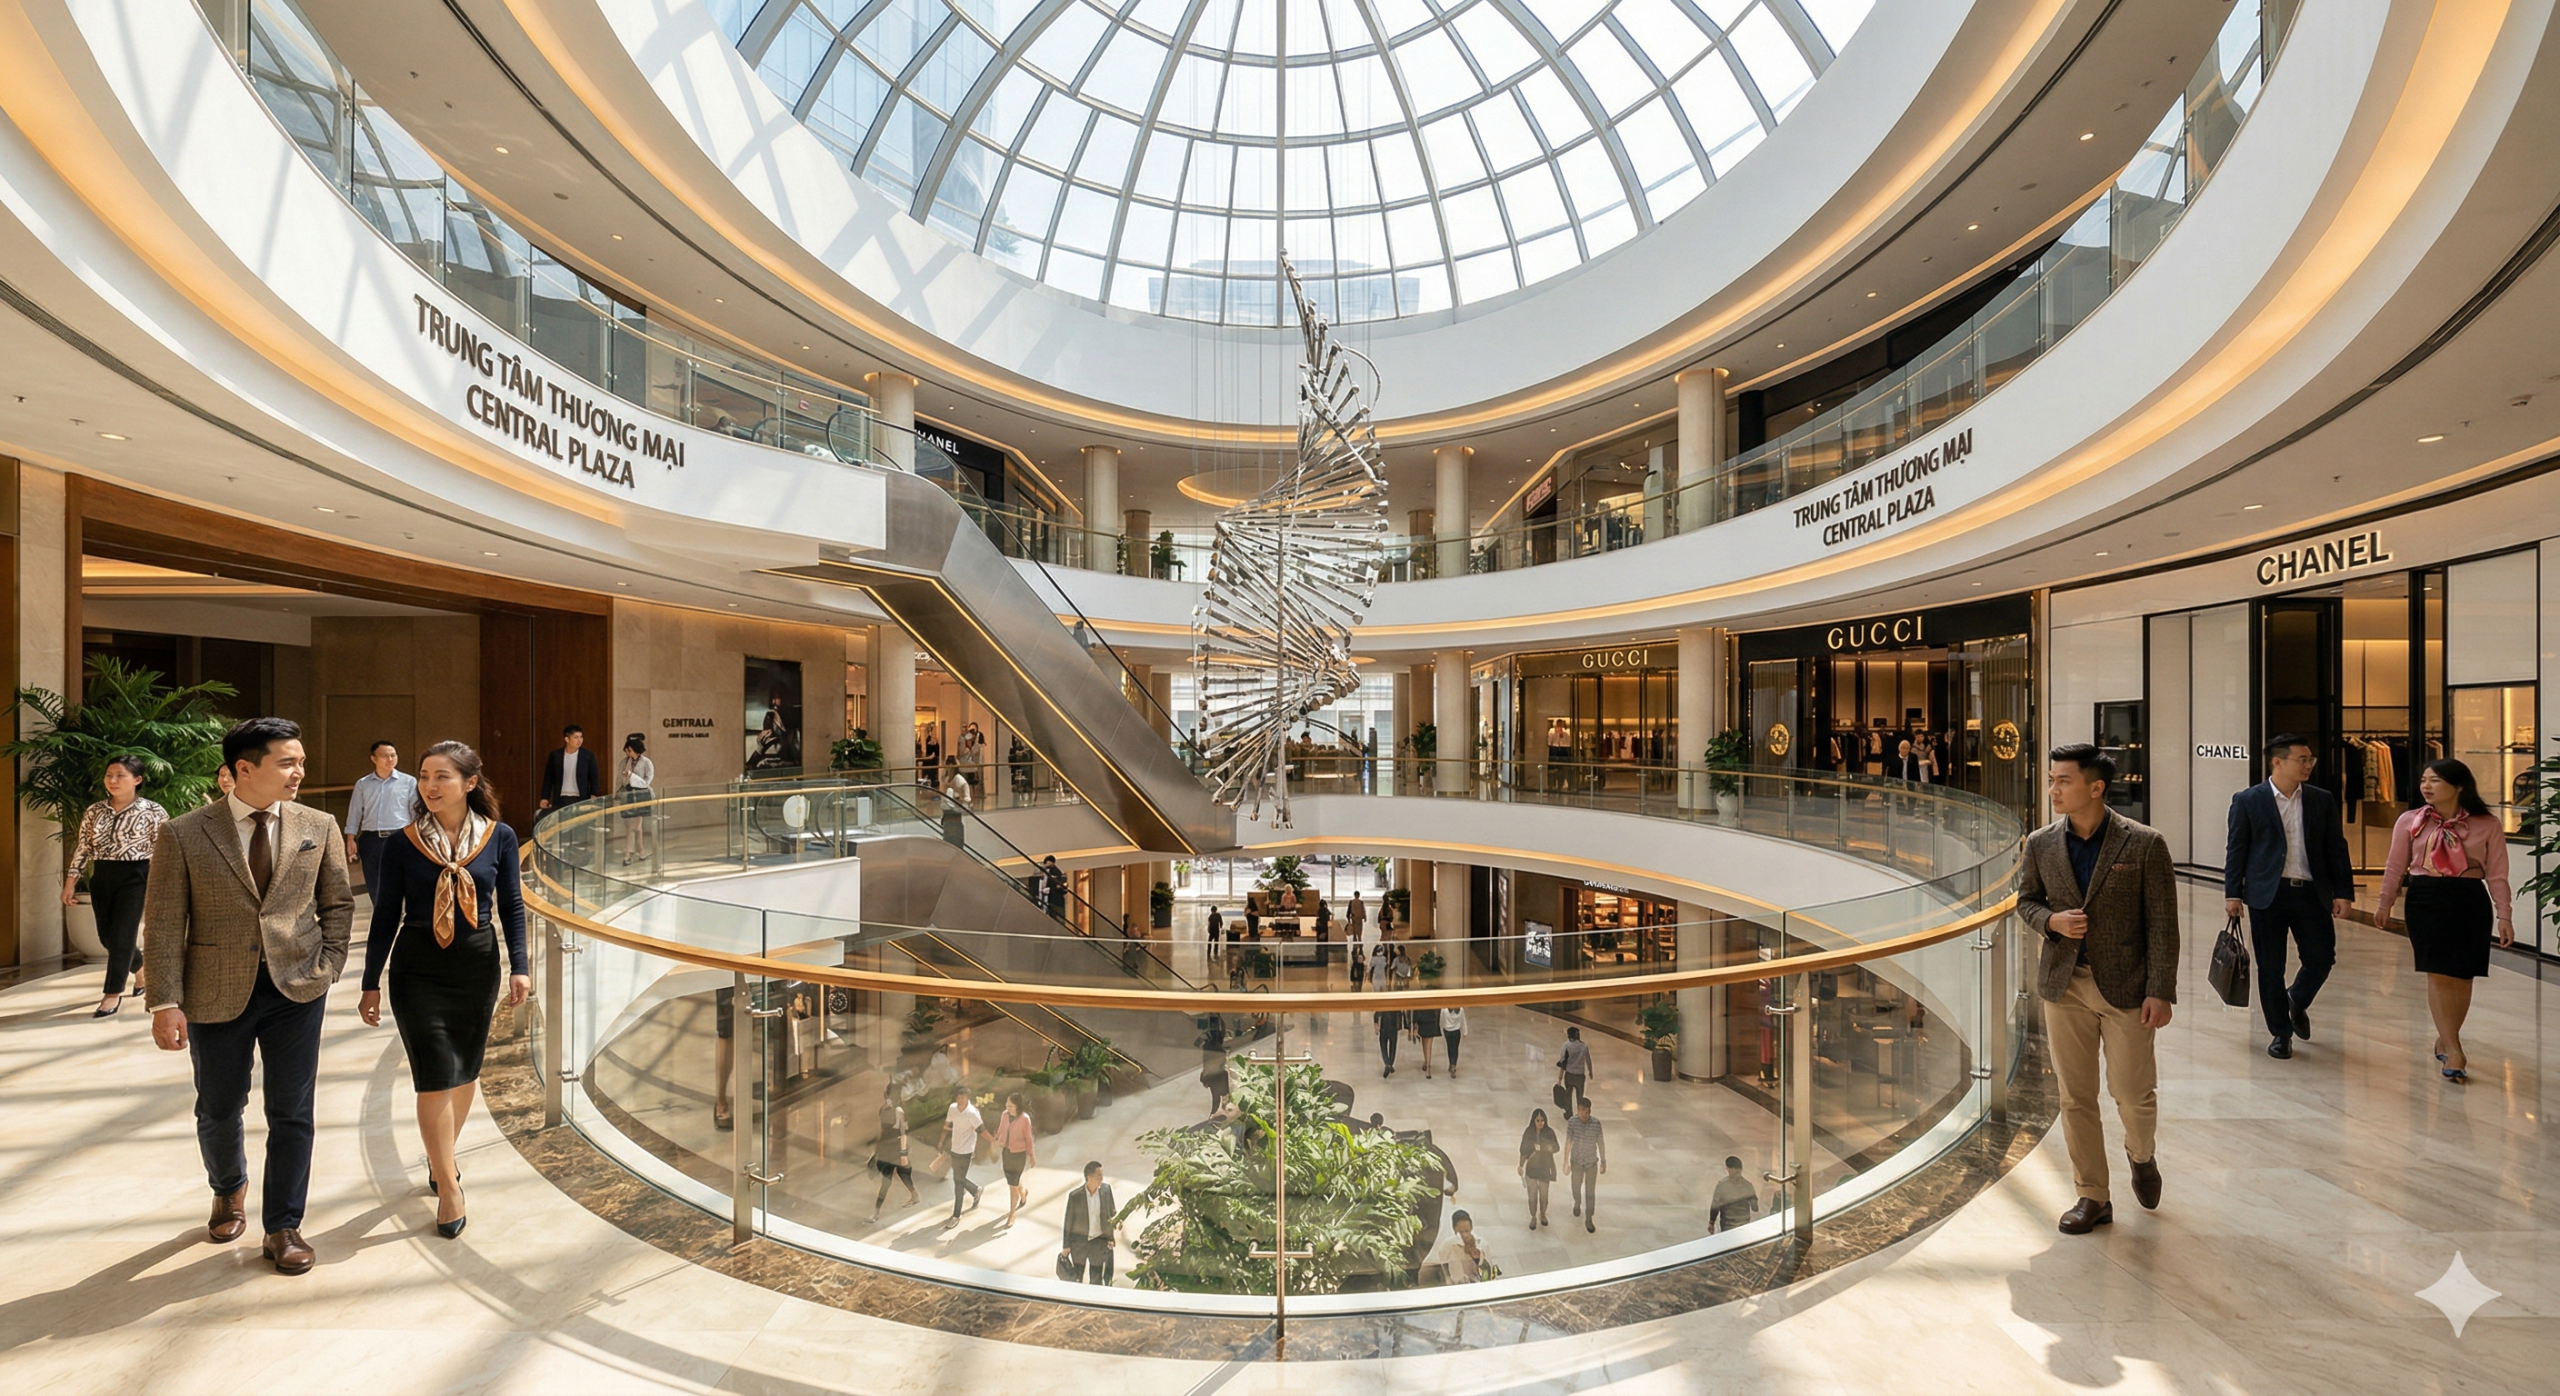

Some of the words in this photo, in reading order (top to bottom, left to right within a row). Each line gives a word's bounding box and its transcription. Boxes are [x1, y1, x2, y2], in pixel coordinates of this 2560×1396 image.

[414, 293, 493, 377] TRUNG
[497, 354, 543, 406] TÂM
[547, 381, 637, 451] THƯƠNG
[642, 429, 685, 471] MẠI
[466, 385, 564, 460] CENTRAL
[568, 436, 635, 489] PLAZA
[1793, 493, 1840, 528] TRUNG
[1843, 480, 1873, 510] TÂM
[1875, 448, 1939, 497] THƯƠNG
[1943, 428, 1973, 467] MẠI
[1823, 507, 1885, 546] CENTRAL
[1887, 485, 1935, 525] PLAZA
[2256, 531, 2391, 586] CHANEL
[1582, 649, 1648, 669] GUCCI
[1827, 616, 1922, 650] GUCCI
[2196, 744, 2248, 759] CHANEL
